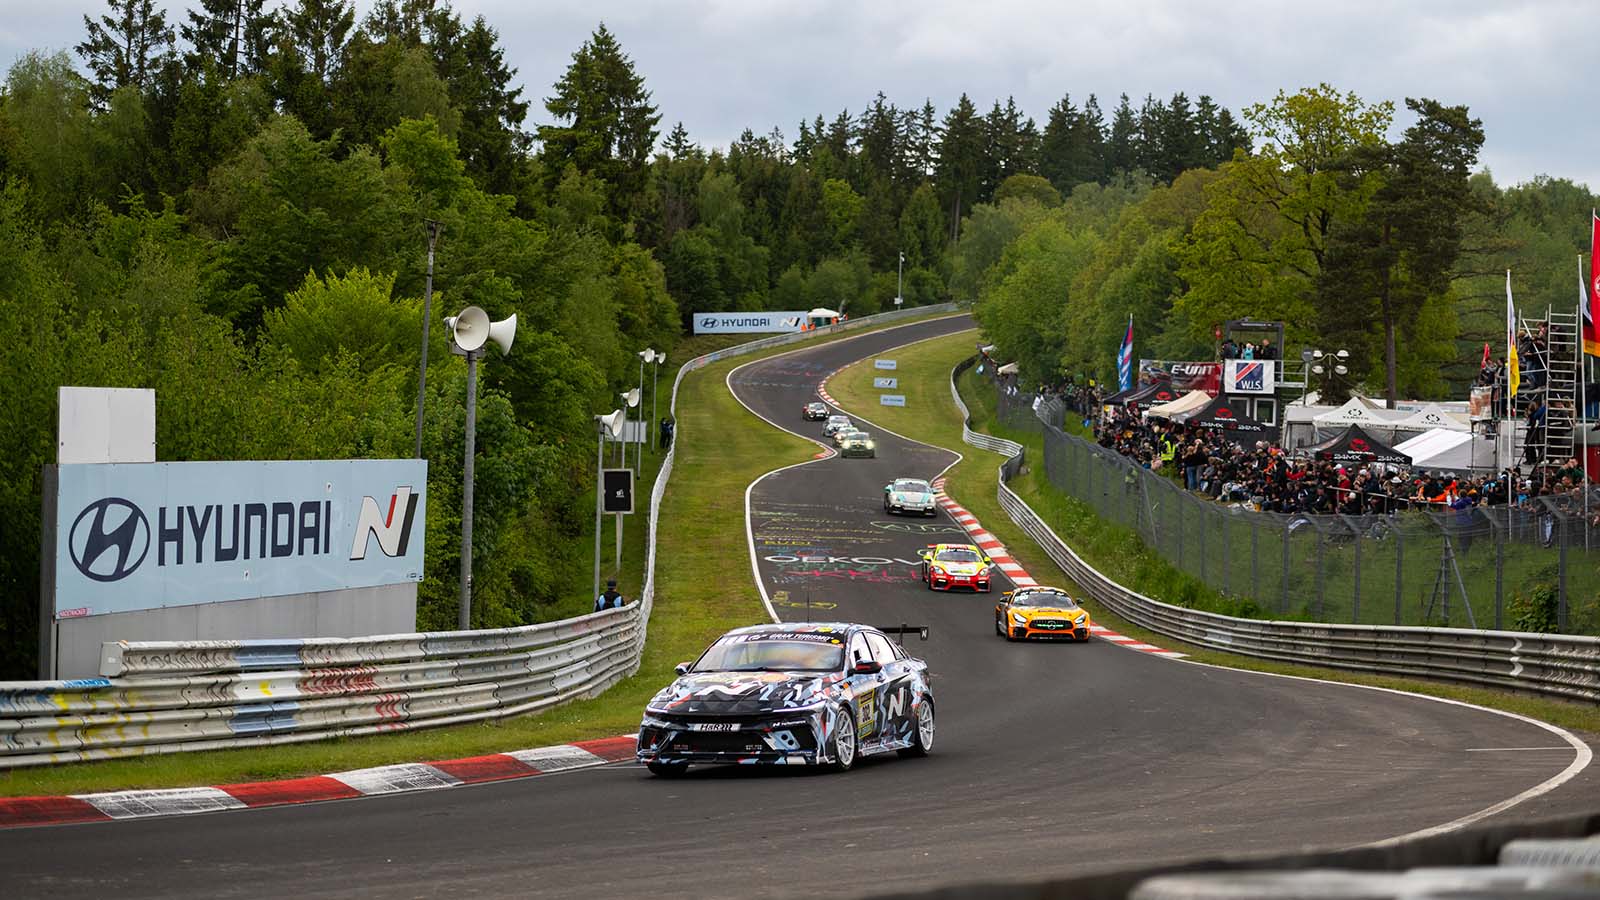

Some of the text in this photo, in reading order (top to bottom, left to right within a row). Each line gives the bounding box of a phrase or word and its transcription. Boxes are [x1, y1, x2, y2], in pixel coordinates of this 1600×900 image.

[721, 318, 770, 327] HYUNDAI
[1171, 364, 1216, 376] E-UNIT
[1241, 380, 1263, 390] W.I.S.
[1334, 453, 1361, 461] 24MX
[1377, 455, 1405, 463] 24MX
[158, 500, 331, 566] HYUNDAI
[769, 633, 793, 641] GRAN
[888, 687, 907, 721] N
